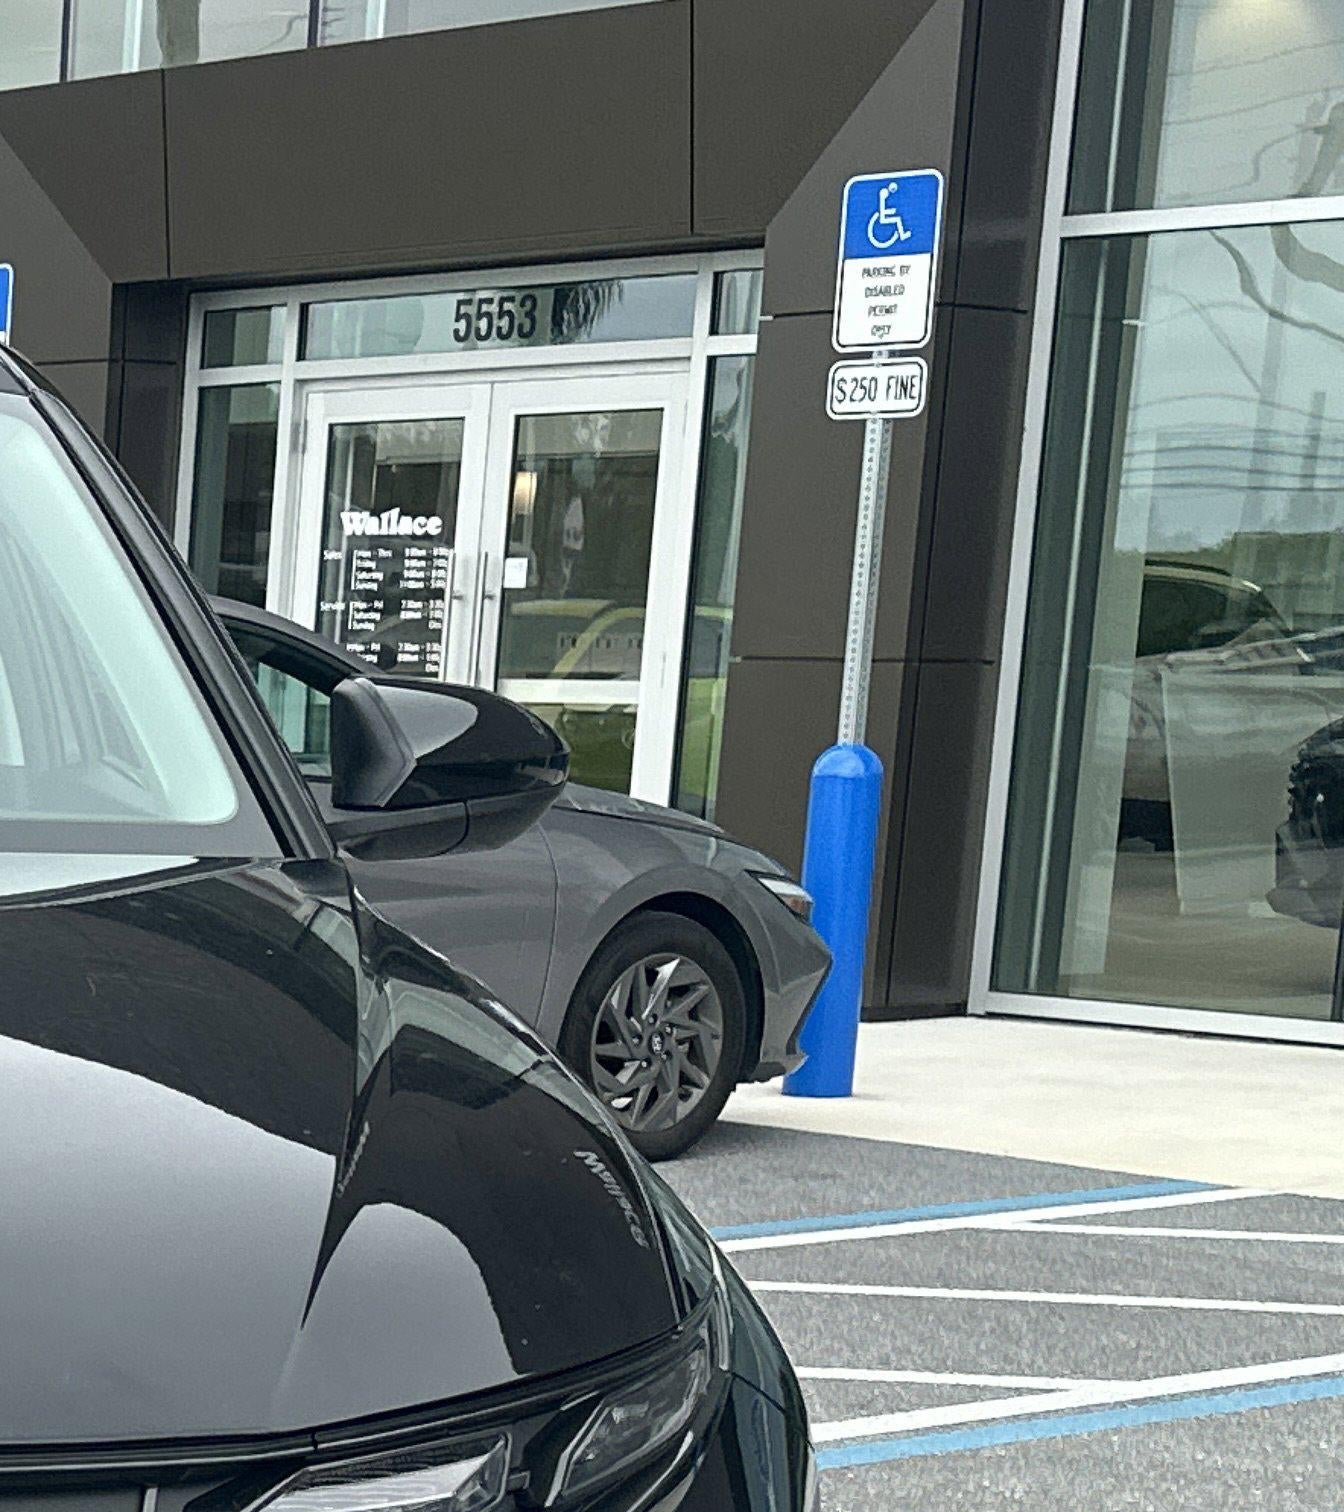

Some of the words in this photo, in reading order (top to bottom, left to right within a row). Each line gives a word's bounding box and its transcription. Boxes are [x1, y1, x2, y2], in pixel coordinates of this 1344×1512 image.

[864, 283, 906, 299] DISABLED
[453, 294, 537, 343] 5553
[835, 376, 878, 404] $250
[886, 374, 919, 401] FINE
[340, 507, 443, 536] Wallace
